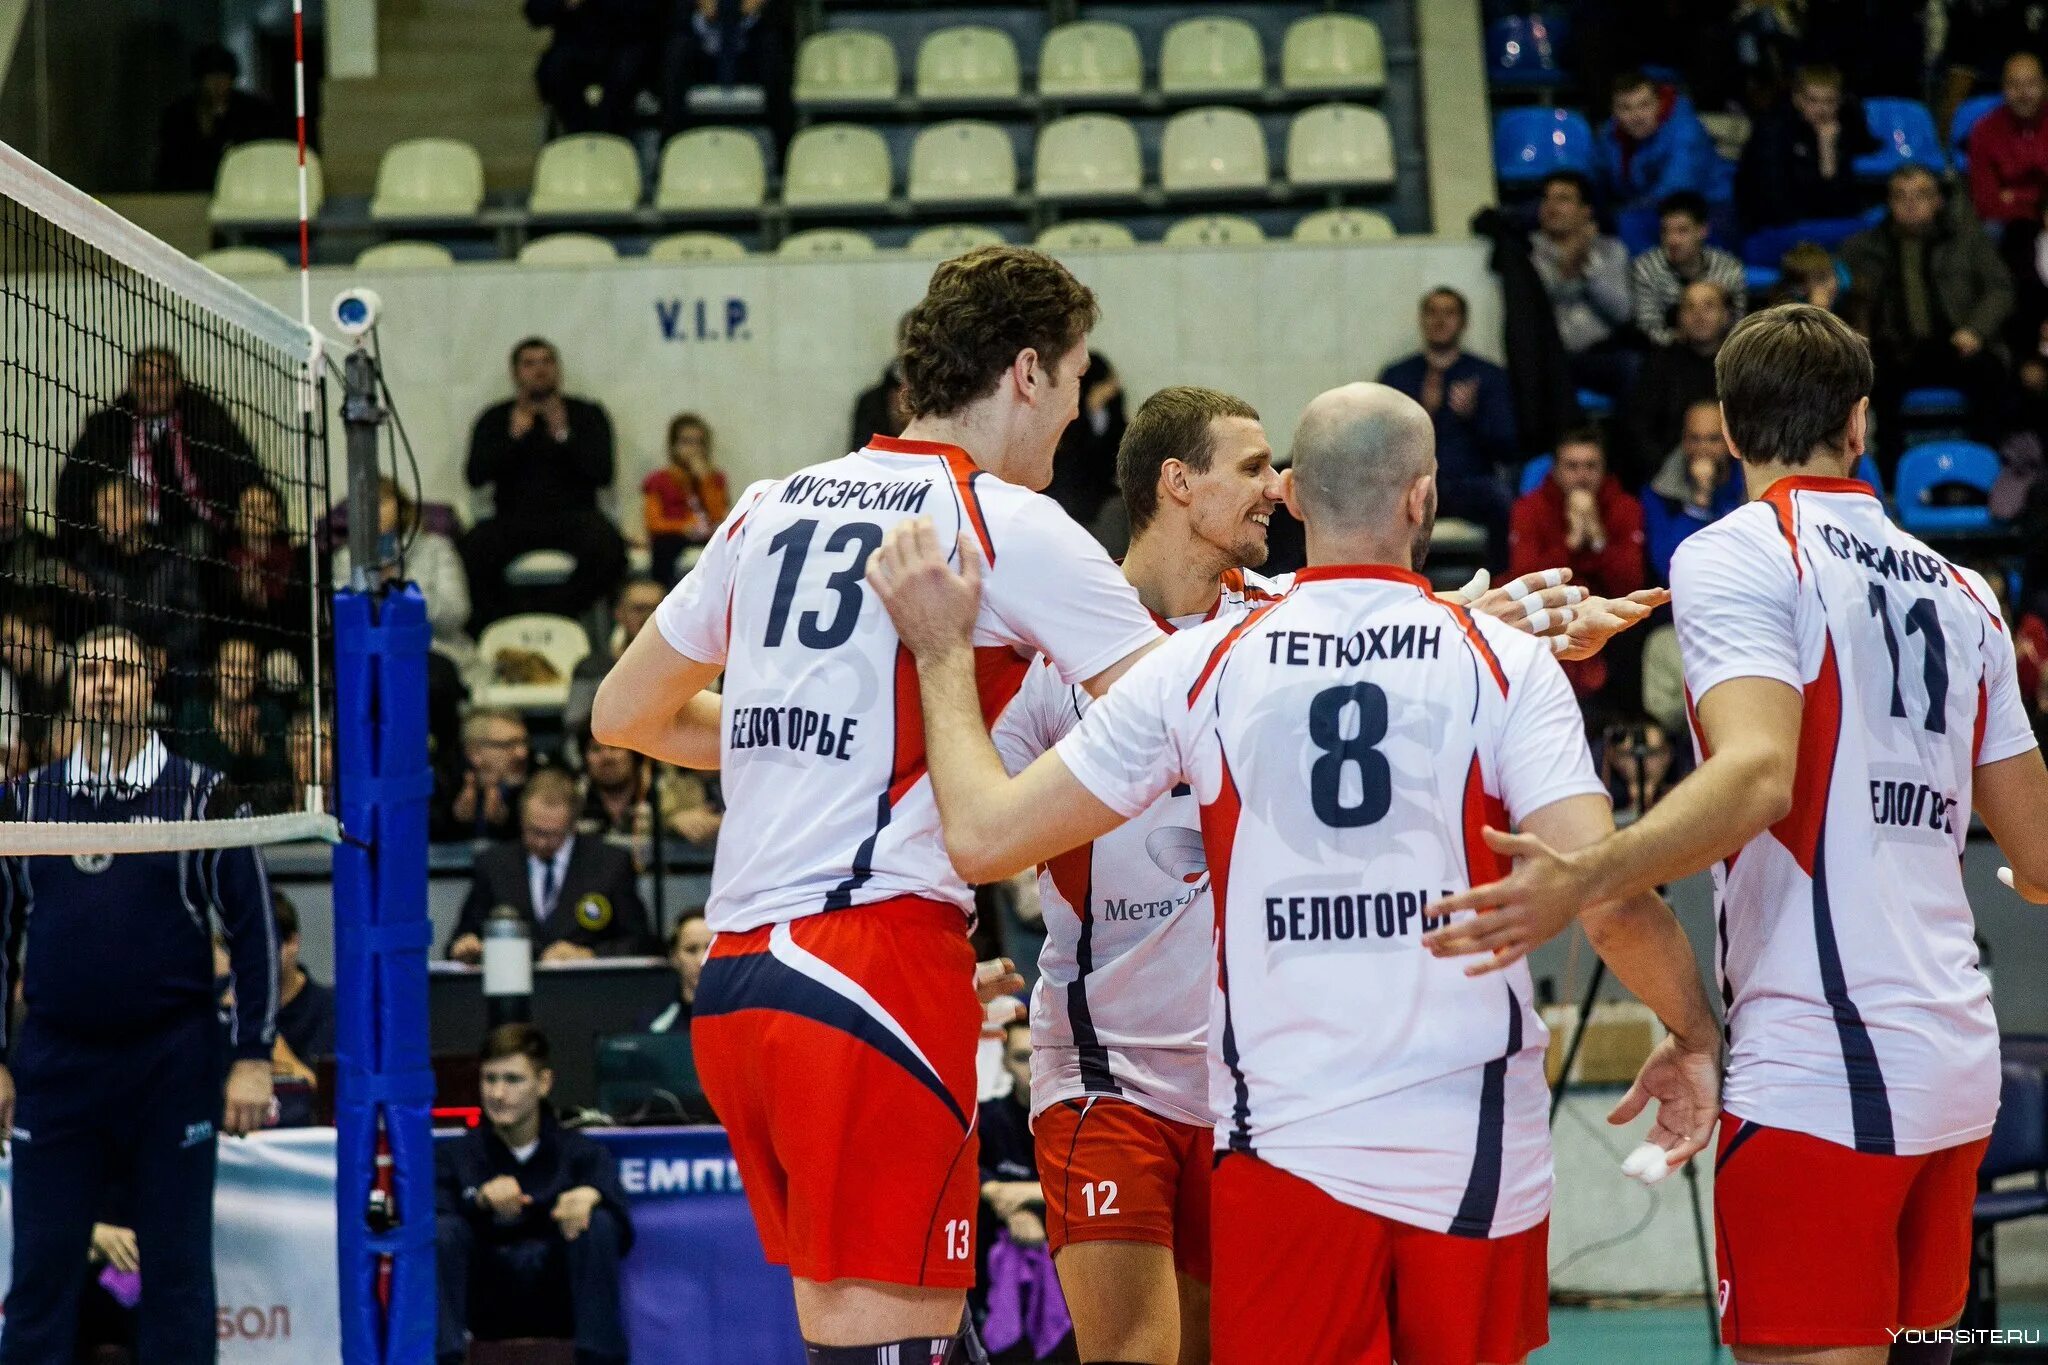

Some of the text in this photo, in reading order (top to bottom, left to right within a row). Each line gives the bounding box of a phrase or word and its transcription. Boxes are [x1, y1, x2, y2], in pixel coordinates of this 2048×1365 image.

[780, 475, 935, 514] МУСЭРСКИЙ
[763, 518, 883, 650] 13
[1266, 625, 1441, 668] ТЕТЮХИН
[1868, 582, 1949, 735] 11
[1309, 681, 1392, 828] 8
[1081, 1180, 1120, 1217] 12
[944, 1219, 970, 1260] 13
